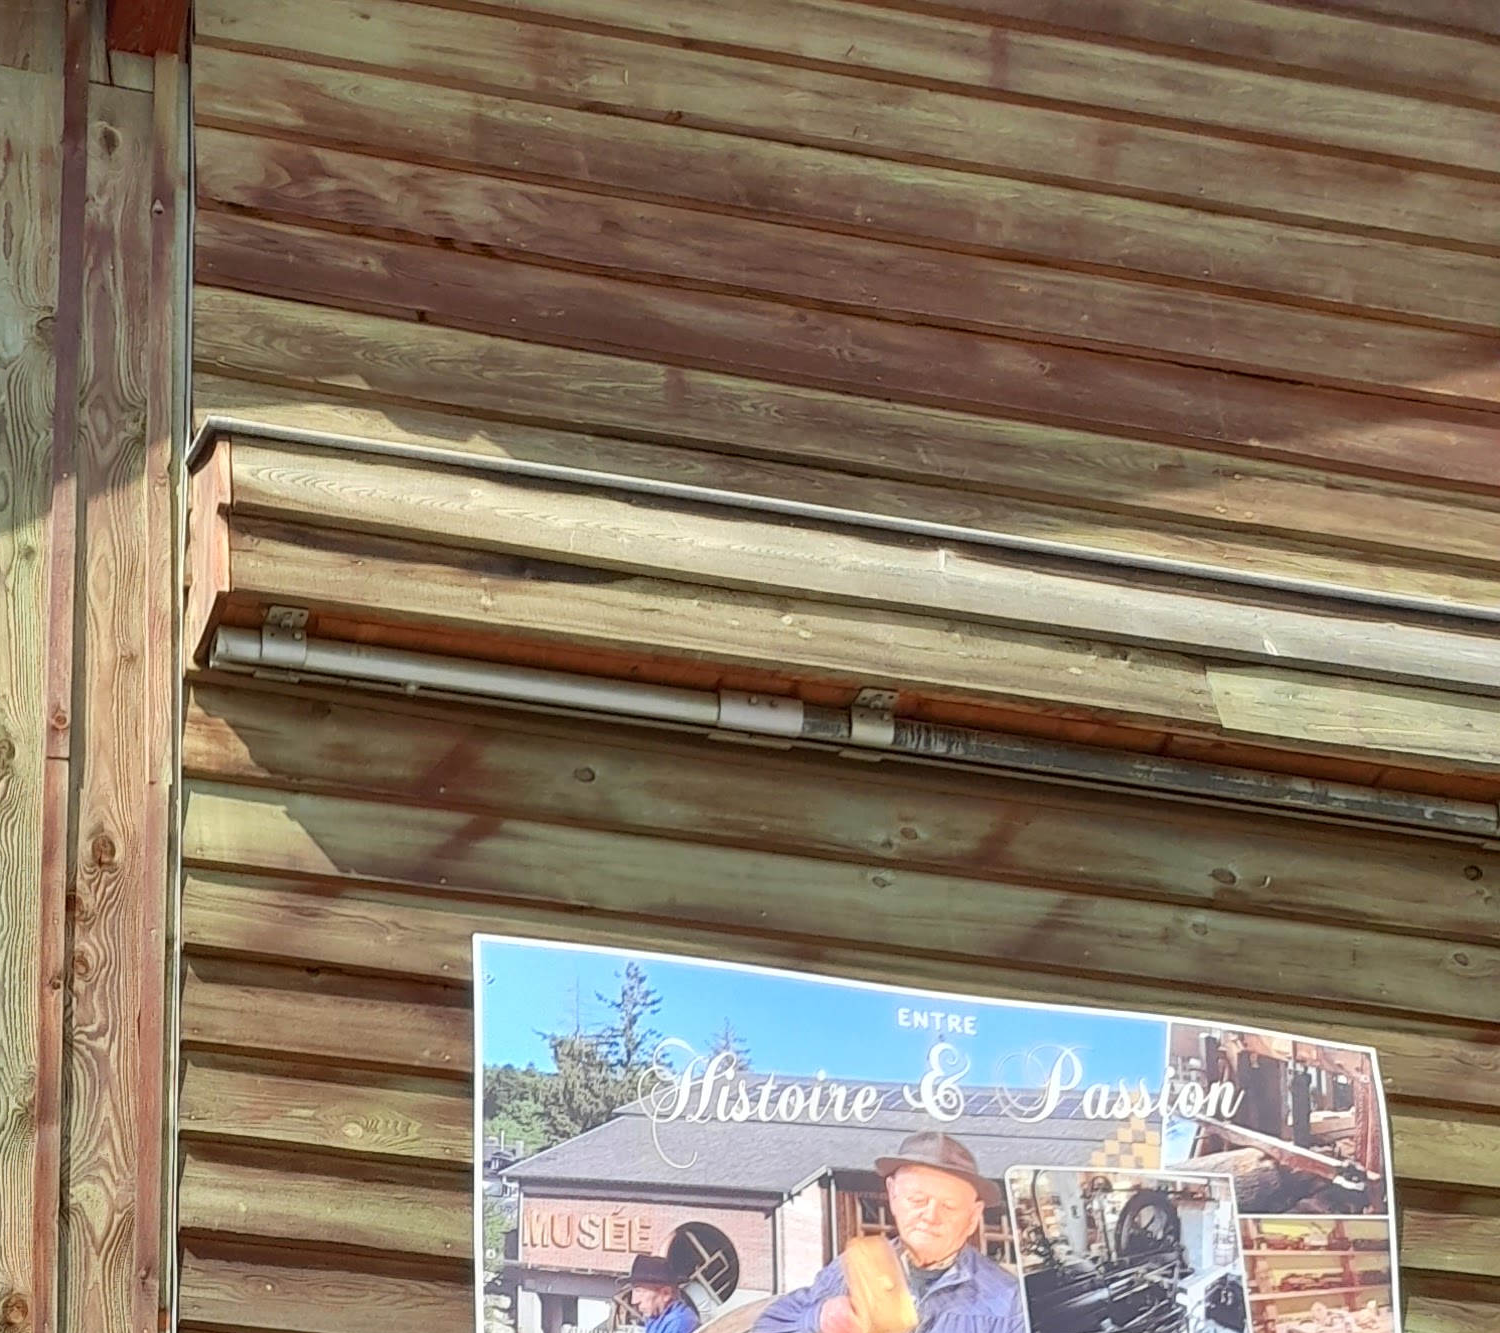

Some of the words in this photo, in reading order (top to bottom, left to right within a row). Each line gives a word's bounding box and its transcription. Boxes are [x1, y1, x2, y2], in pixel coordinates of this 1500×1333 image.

[897, 1006, 978, 1036] ENTRE
[637, 1037, 881, 1168] Histoire
[904, 1040, 971, 1122] &
[997, 1044, 1246, 1124] Passion
[522, 1205, 653, 1254] MUSÉE
